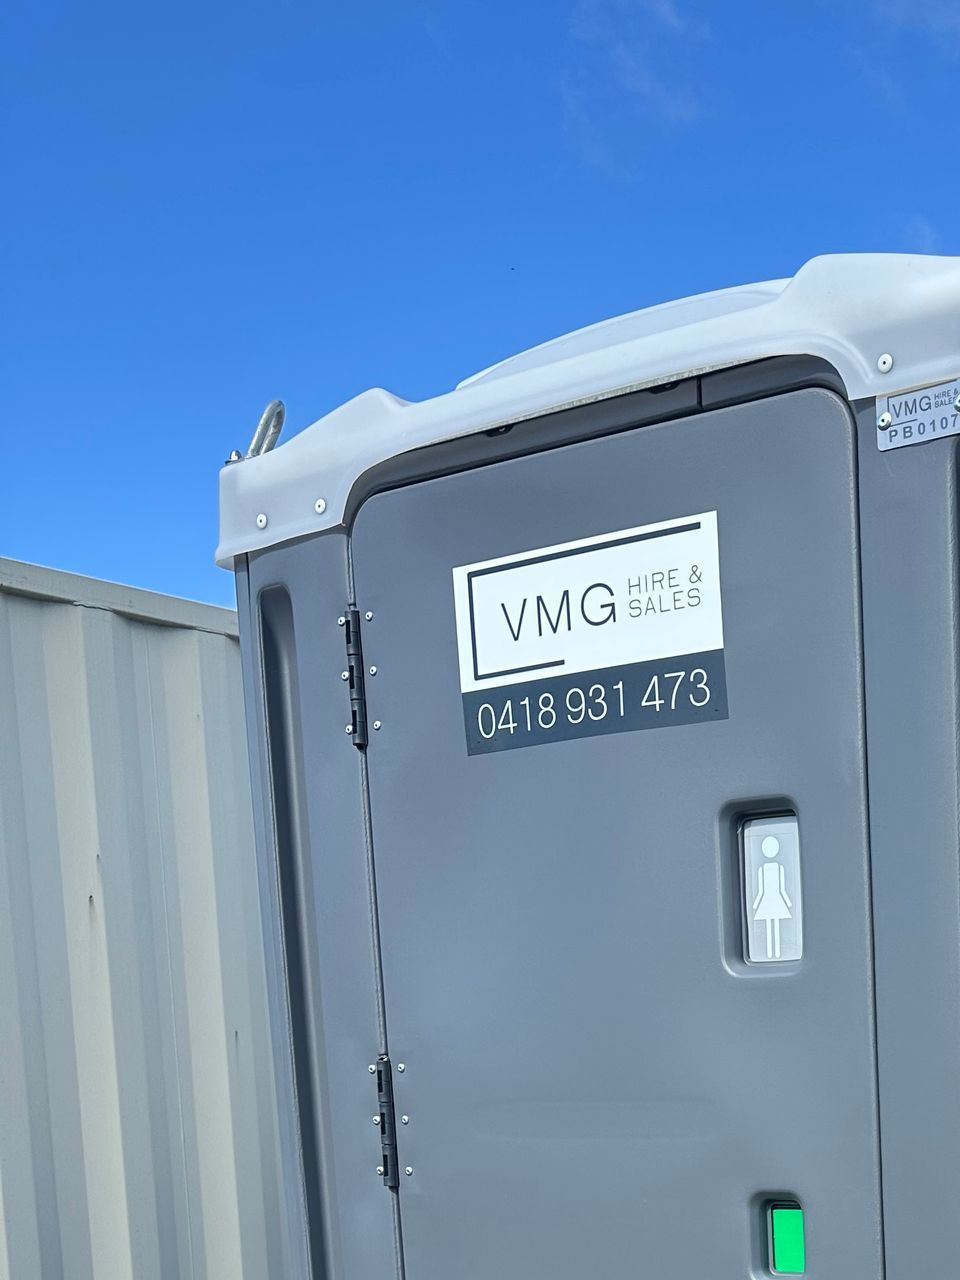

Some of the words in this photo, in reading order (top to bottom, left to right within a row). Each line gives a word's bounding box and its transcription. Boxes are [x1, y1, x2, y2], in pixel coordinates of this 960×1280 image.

[892, 396, 932, 418] VMG
[934, 390, 951, 400] HIRE
[889, 413, 958, 442] PB0107
[628, 569, 680, 595] HIRE
[689, 565, 702, 583] &
[501, 583, 616, 641] VMG
[629, 588, 701, 618] SALES
[478, 693, 556, 738] 0418
[566, 681, 624, 724] 931
[641, 668, 710, 712] 473
